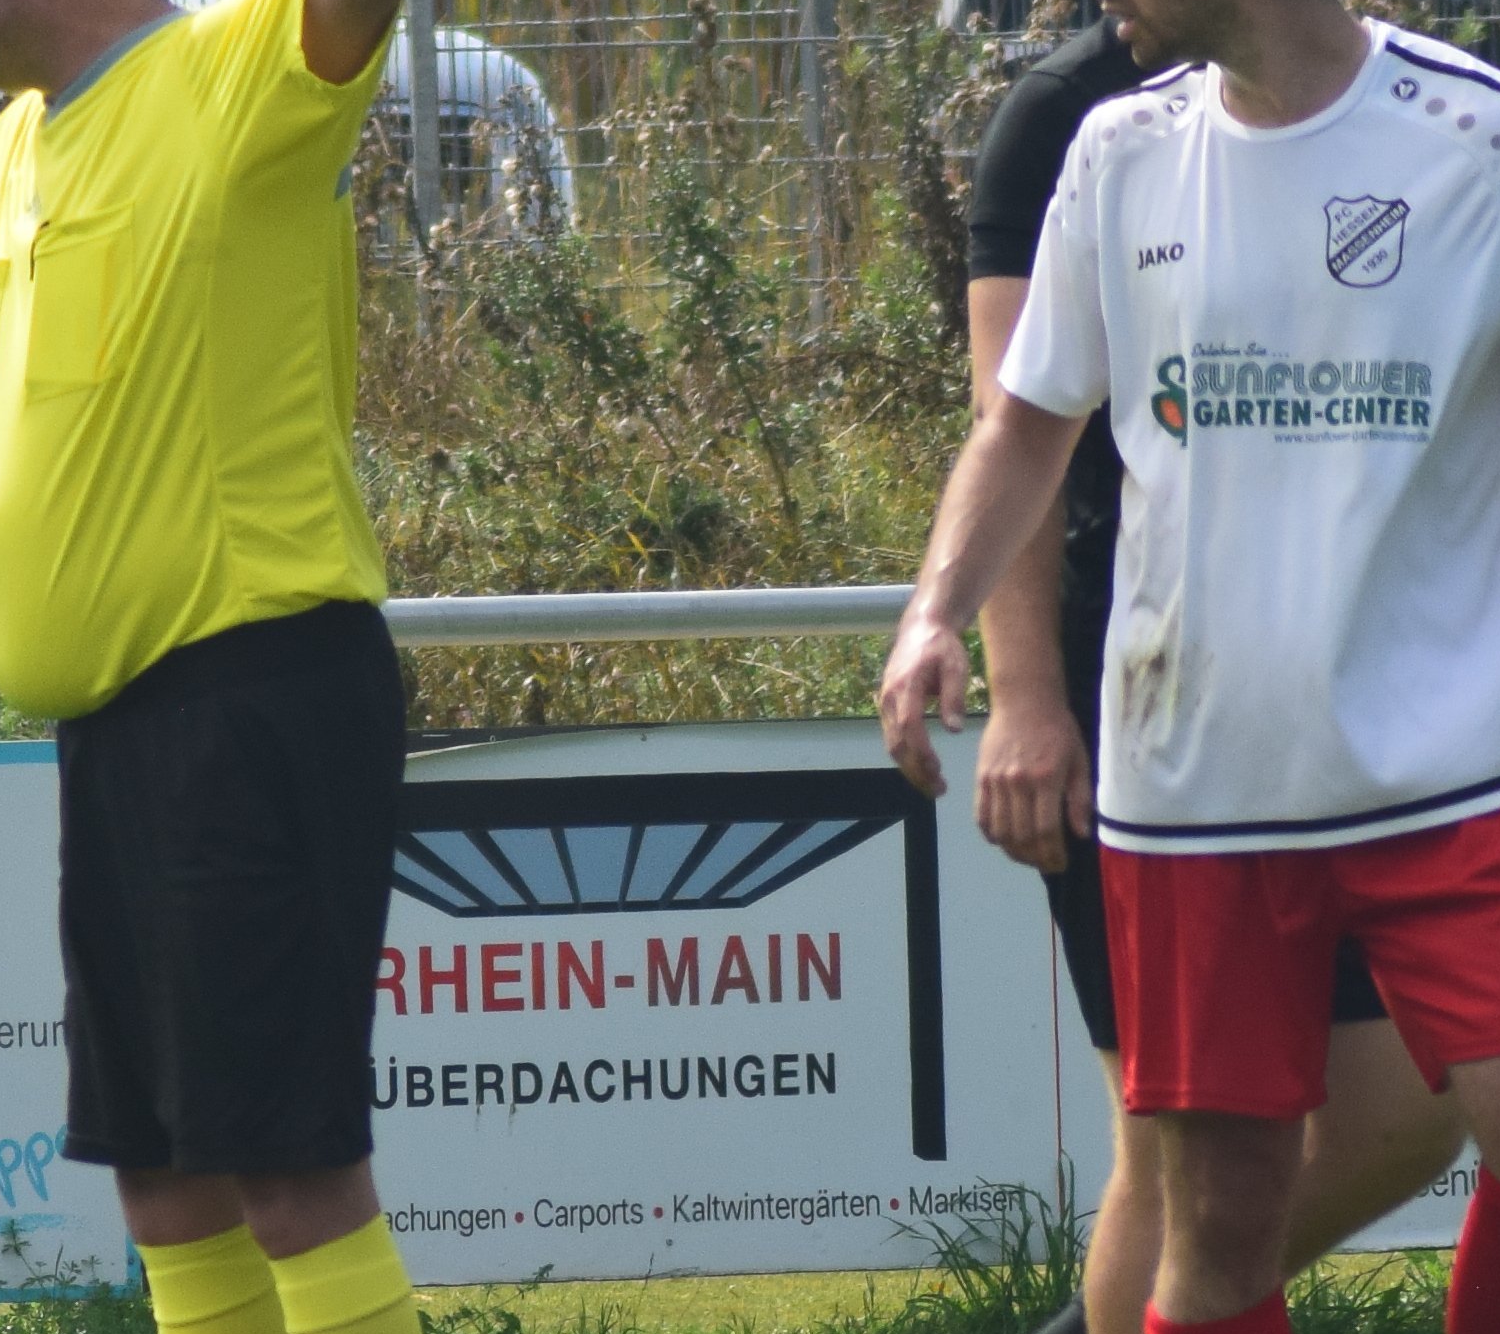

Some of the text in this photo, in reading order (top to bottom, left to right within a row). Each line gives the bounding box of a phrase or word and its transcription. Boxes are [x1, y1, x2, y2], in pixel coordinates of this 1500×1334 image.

[1138, 243, 1184, 271] JAKO
[1192, 360, 1432, 397] SUNFLOWER
[1193, 397, 1431, 428] GARTEN-CENTER
[375, 932, 843, 1016] RHEIN-MAIN
[369, 1052, 838, 1111] ÜBERDACHUNGEN
[384, 1201, 507, 1238] achungen
[532, 1198, 645, 1234] Carports
[672, 1188, 881, 1226] Kaltwintergärten
